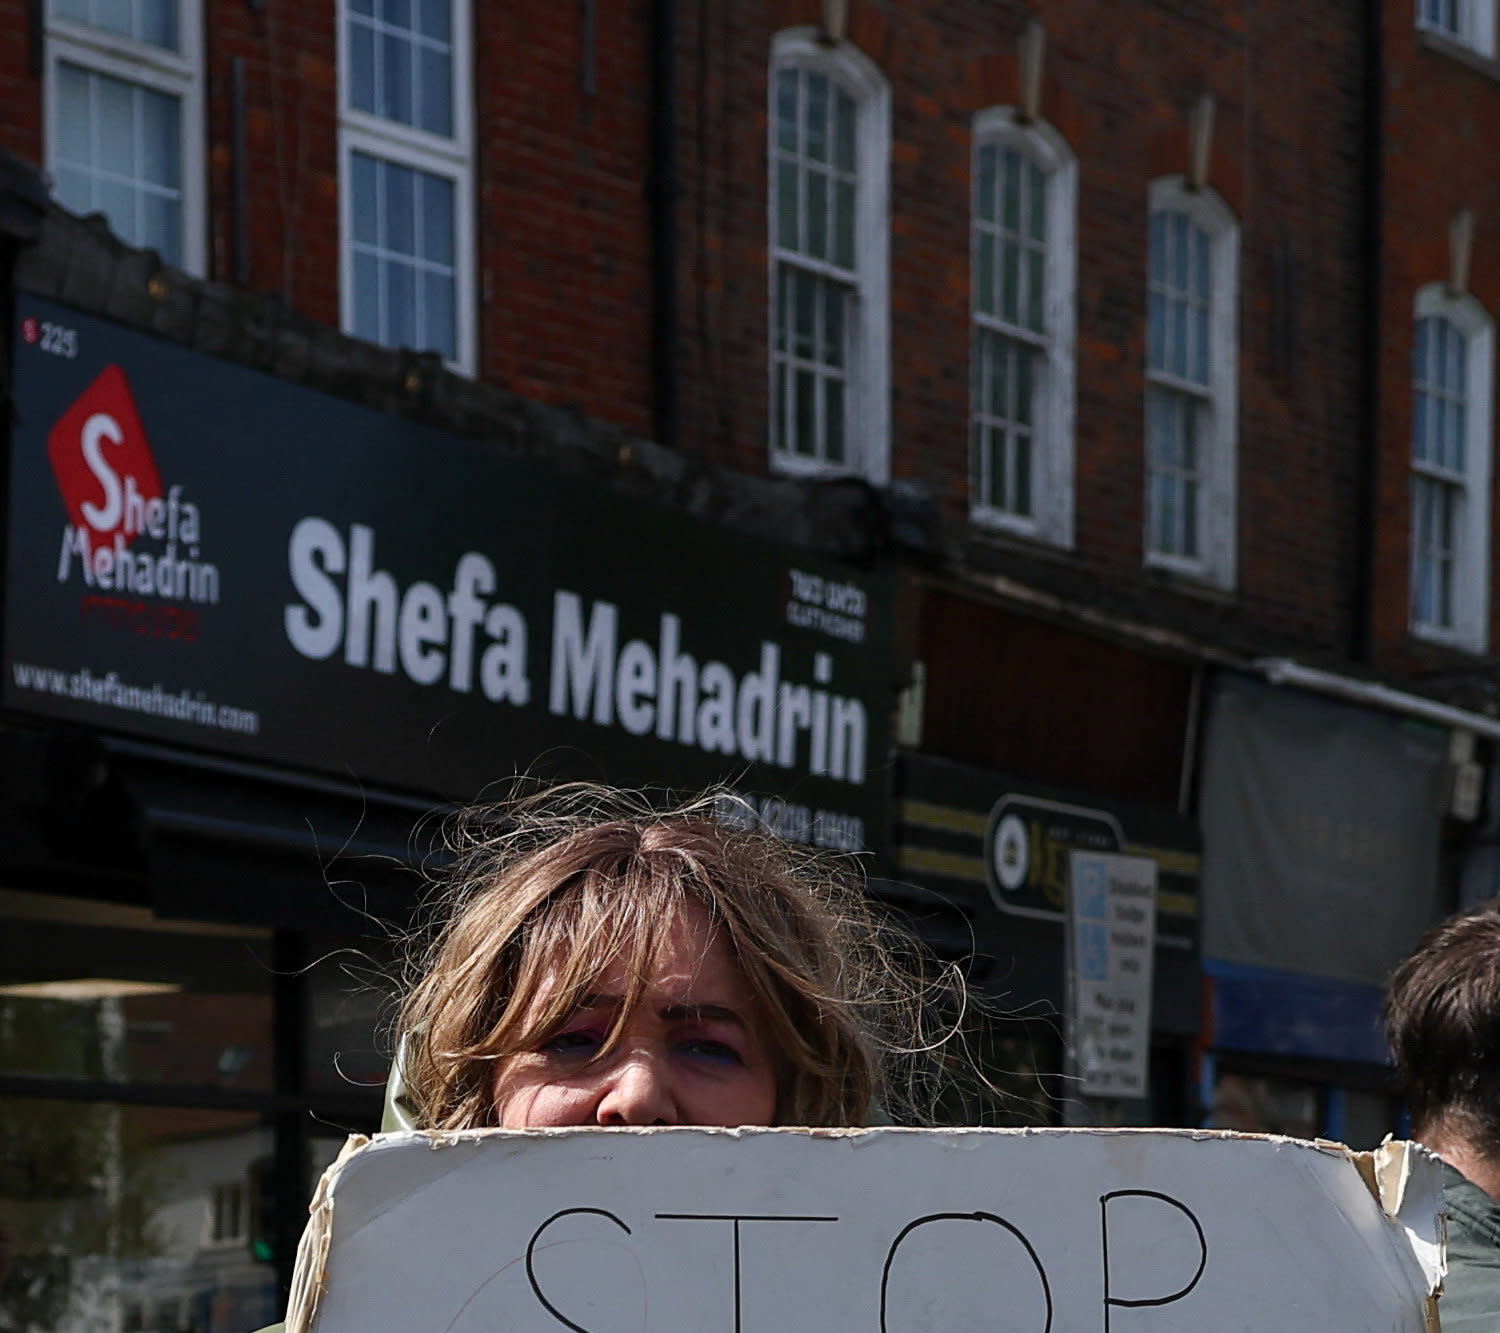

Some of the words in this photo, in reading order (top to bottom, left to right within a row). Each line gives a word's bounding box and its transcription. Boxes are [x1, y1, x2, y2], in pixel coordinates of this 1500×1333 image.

[39, 321, 80, 360] 225
[79, 411, 201, 546] Shefa
[57, 523, 221, 606] Mehadrin
[284, 514, 531, 707] Shefa
[549, 588, 868, 786] Mehadrin
[12, 660, 261, 736] www.shefamehadrin.com
